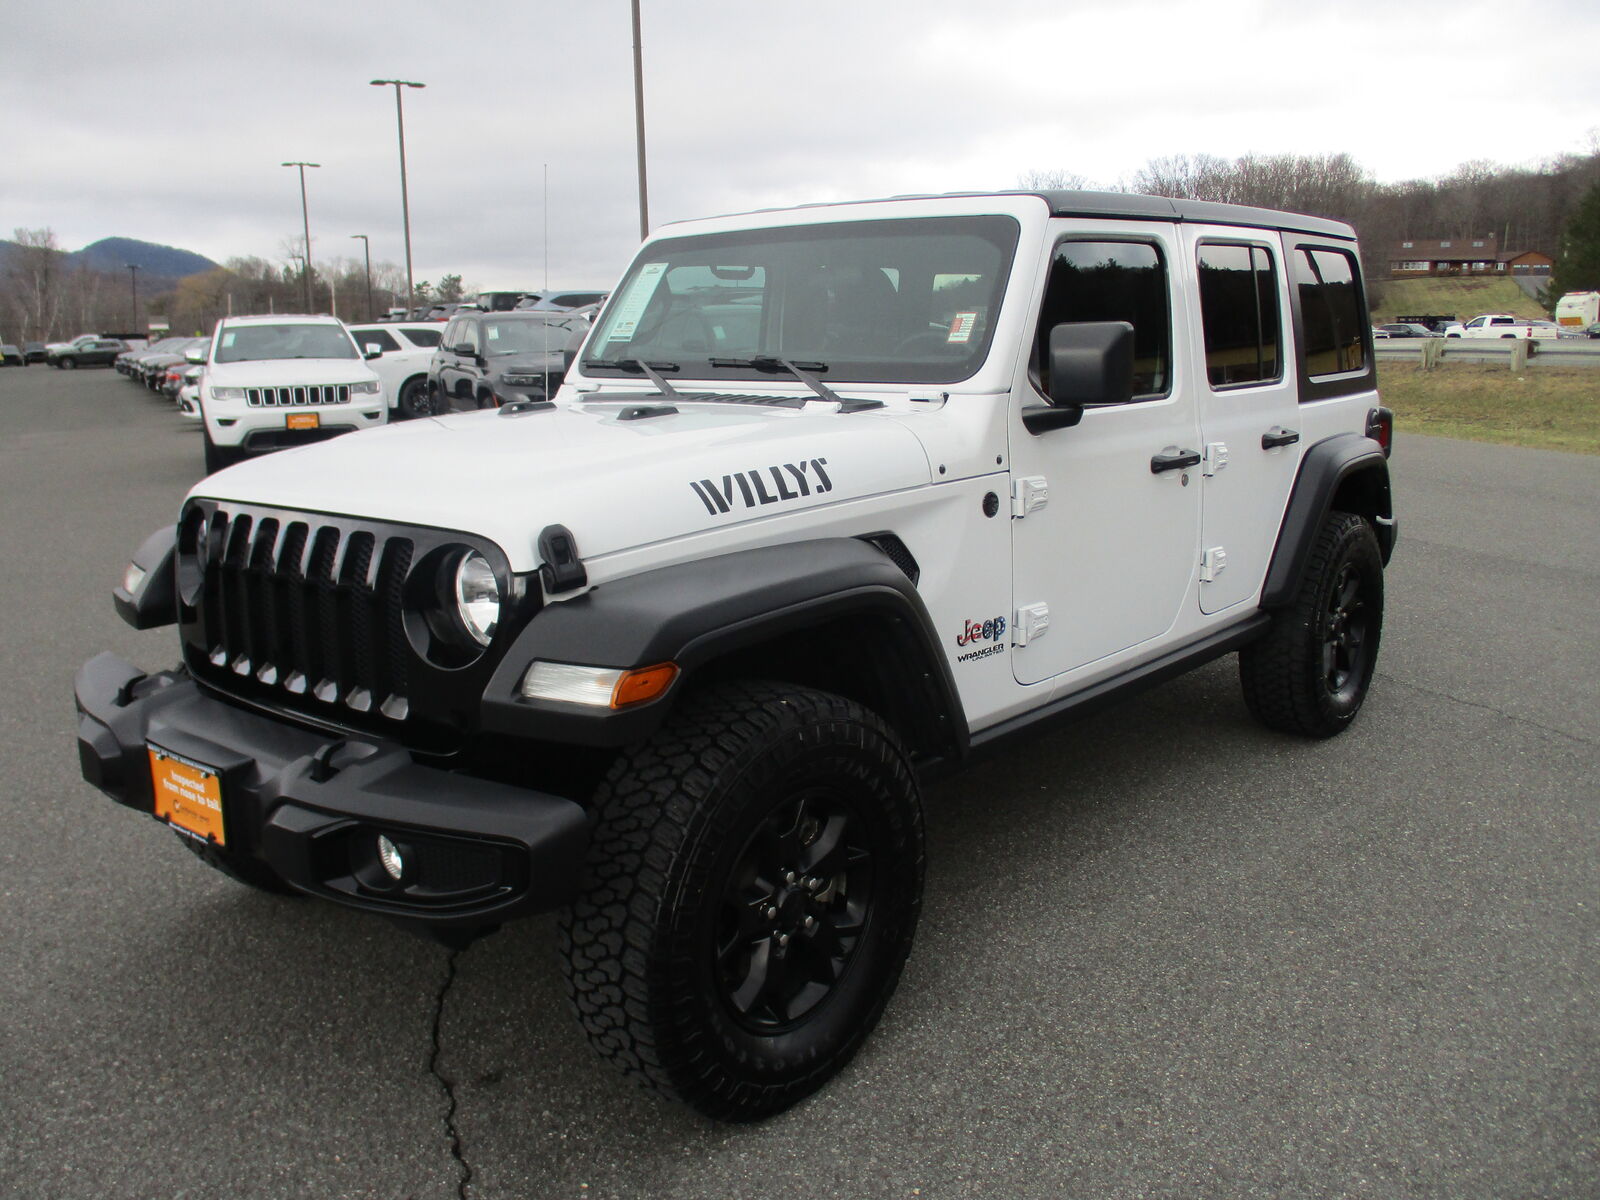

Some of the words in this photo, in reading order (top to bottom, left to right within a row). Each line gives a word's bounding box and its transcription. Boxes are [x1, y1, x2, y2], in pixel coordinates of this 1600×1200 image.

[689, 457, 833, 516] WILLYS
[957, 616, 1006, 647] Jeep
[957, 643, 1004, 663] WRANGLER
[163, 778, 179, 794] from
[196, 793, 206, 805] to
[171, 769, 205, 793] Inspected
